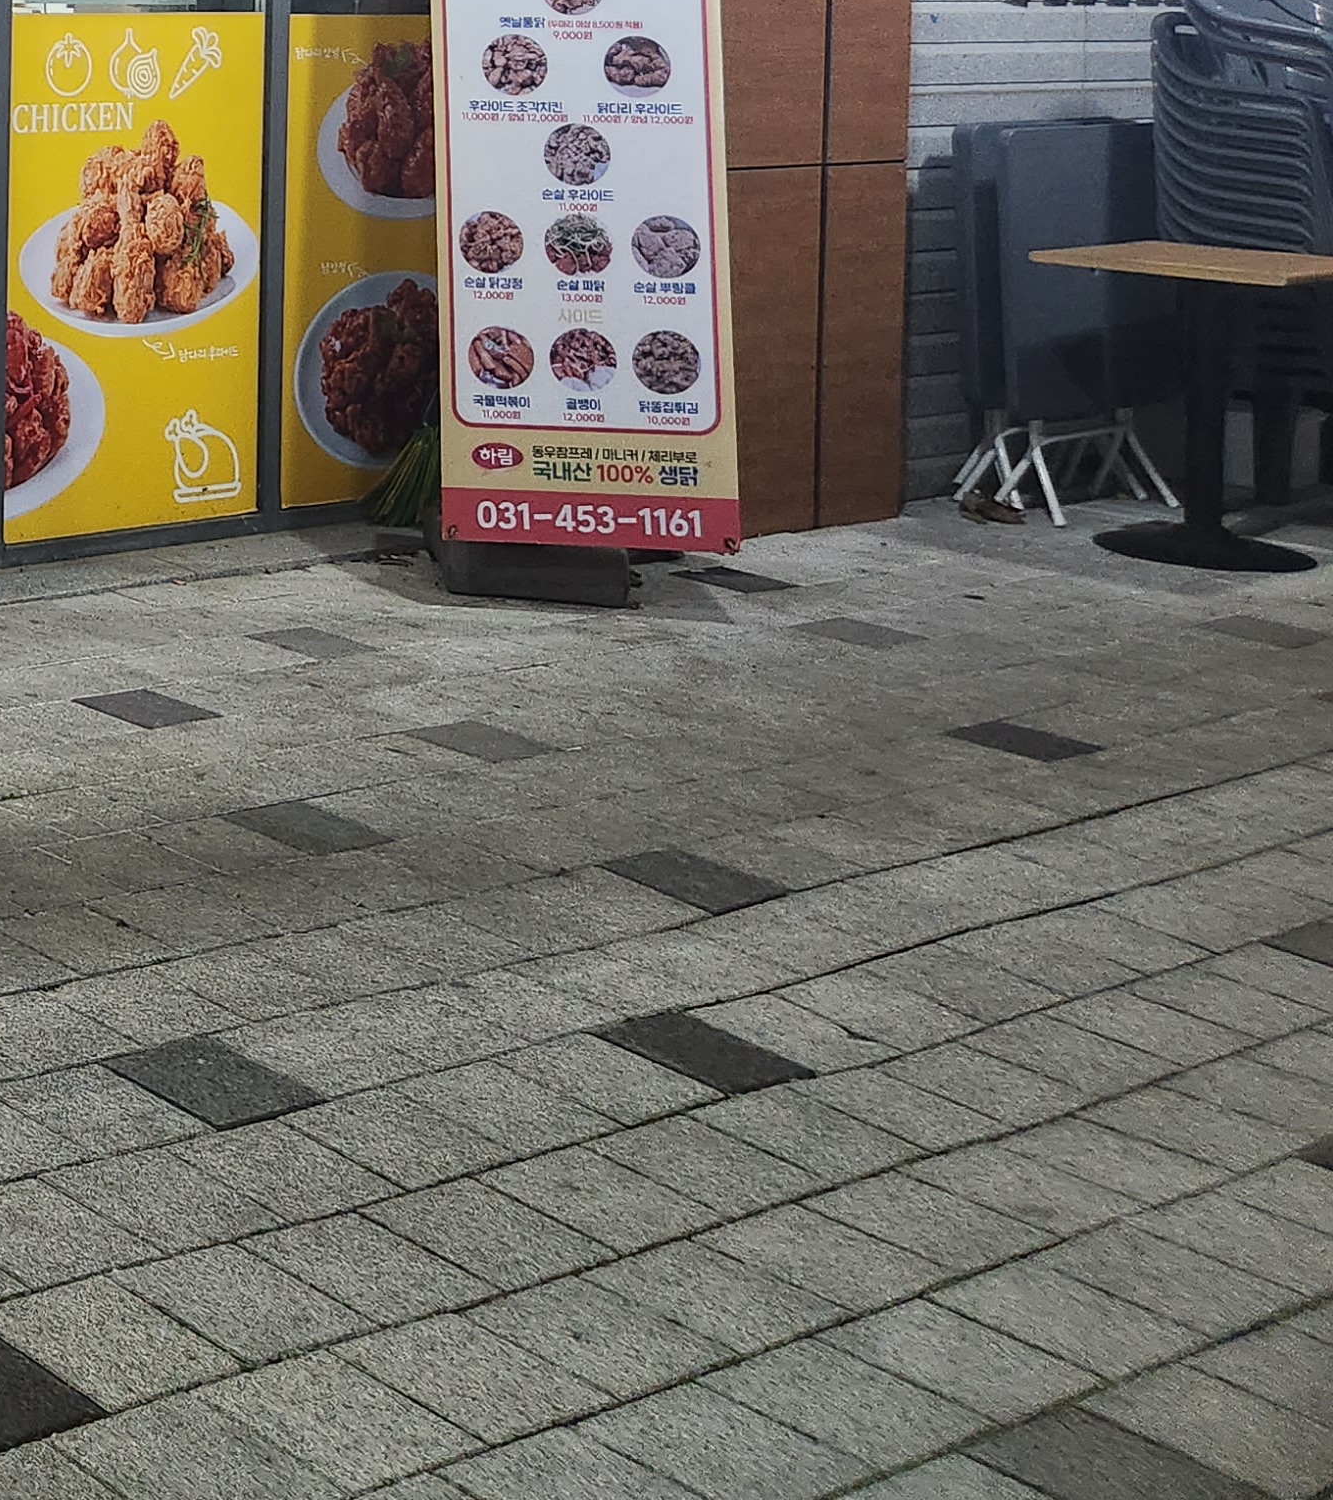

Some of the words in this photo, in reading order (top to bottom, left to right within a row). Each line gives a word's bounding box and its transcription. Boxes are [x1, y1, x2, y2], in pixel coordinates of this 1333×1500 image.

[499, 16, 546, 29] 옛날통닭
[552, 30, 593, 40] 9,000원
[468, 100, 514, 112] 후라이드
[516, 101, 563, 113] 조각치킨
[597, 102, 632, 114] 닭다리
[634, 103, 683, 115] 후라이드
[12, 102, 135, 134] CHICKEN
[461, 111, 499, 122] 11,000원
[527, 113, 569, 123] 12,000원
[582, 114, 621, 124] 11,000원
[650, 115, 694, 125] 12,000원
[542, 188, 565, 200] 순살
[567, 189, 614, 201] 후라이드
[559, 203, 597, 212] 11,000원
[463, 276, 486, 289] 순살
[488, 277, 523, 290] 닭강정
[556, 279, 579, 291] 순살
[582, 280, 605, 292] 파닭
[633, 281, 657, 293] 순살
[472, 290, 514, 300] 12,000원
[561, 293, 603, 303] 13,000원
[643, 295, 686, 305] 12,000원
[558, 308, 604, 324] 사이드
[472, 394, 531, 409] 국물떡볶이
[565, 397, 602, 411] 골뱅이
[638, 400, 699, 415] 닭똥집튀김
[481, 409, 521, 420] 11,000원
[562, 412, 605, 423] 12,000원
[646, 415, 691, 426] 10,000원
[478, 444, 514, 466] 하림
[532, 445, 593, 460] 동우참프레
[602, 448, 638, 462] 마니커
[648, 450, 697, 464] 체리부로
[532, 460, 592, 482] 국내산
[596, 464, 654, 484] 100%
[658, 465, 699, 487] 생닭
[476, 500, 702, 538] 031-453-1161
